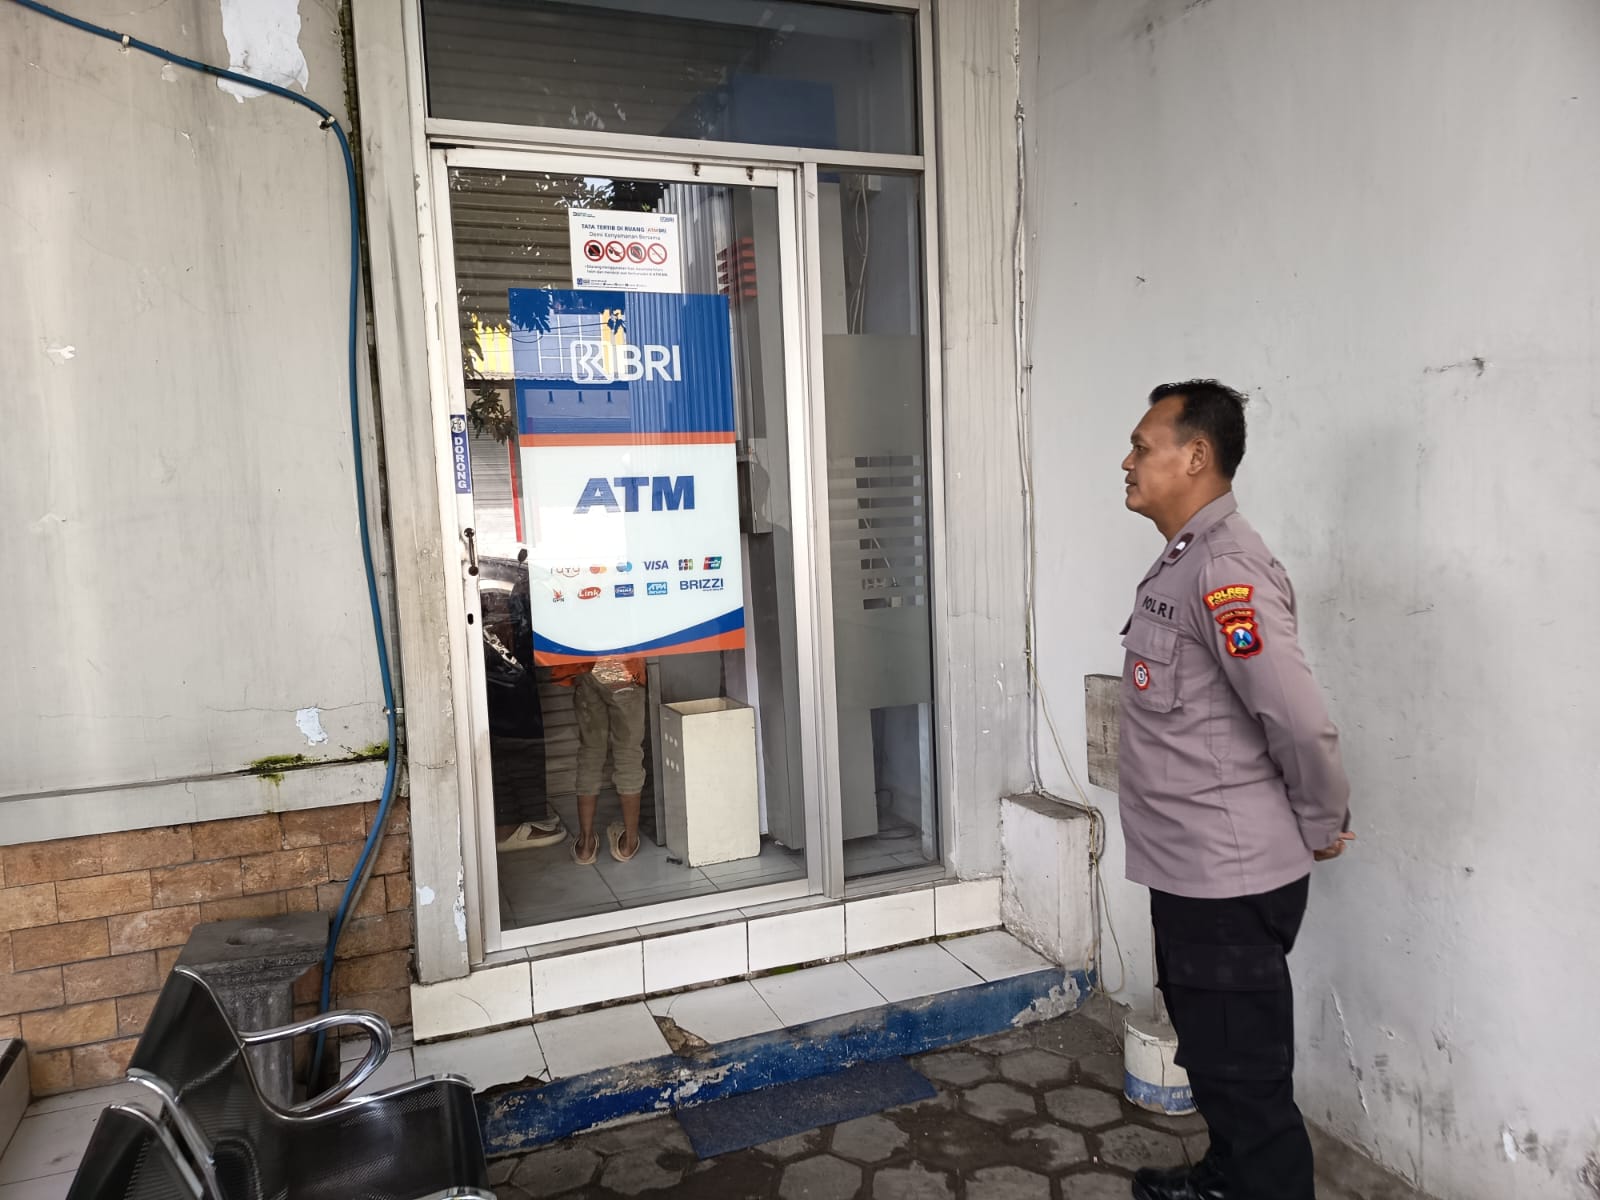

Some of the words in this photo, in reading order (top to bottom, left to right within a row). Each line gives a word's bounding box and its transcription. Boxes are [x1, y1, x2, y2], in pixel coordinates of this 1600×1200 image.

[604, 232, 638, 240] Kenyamanan
[615, 344, 682, 382] BRI
[454, 436, 467, 489] DORONG
[573, 475, 695, 514] ATM
[643, 560, 669, 570] VISA
[679, 577, 724, 590] BRIZZI
[579, 589, 599, 597] Link
[1207, 587, 1250, 606] POLRES
